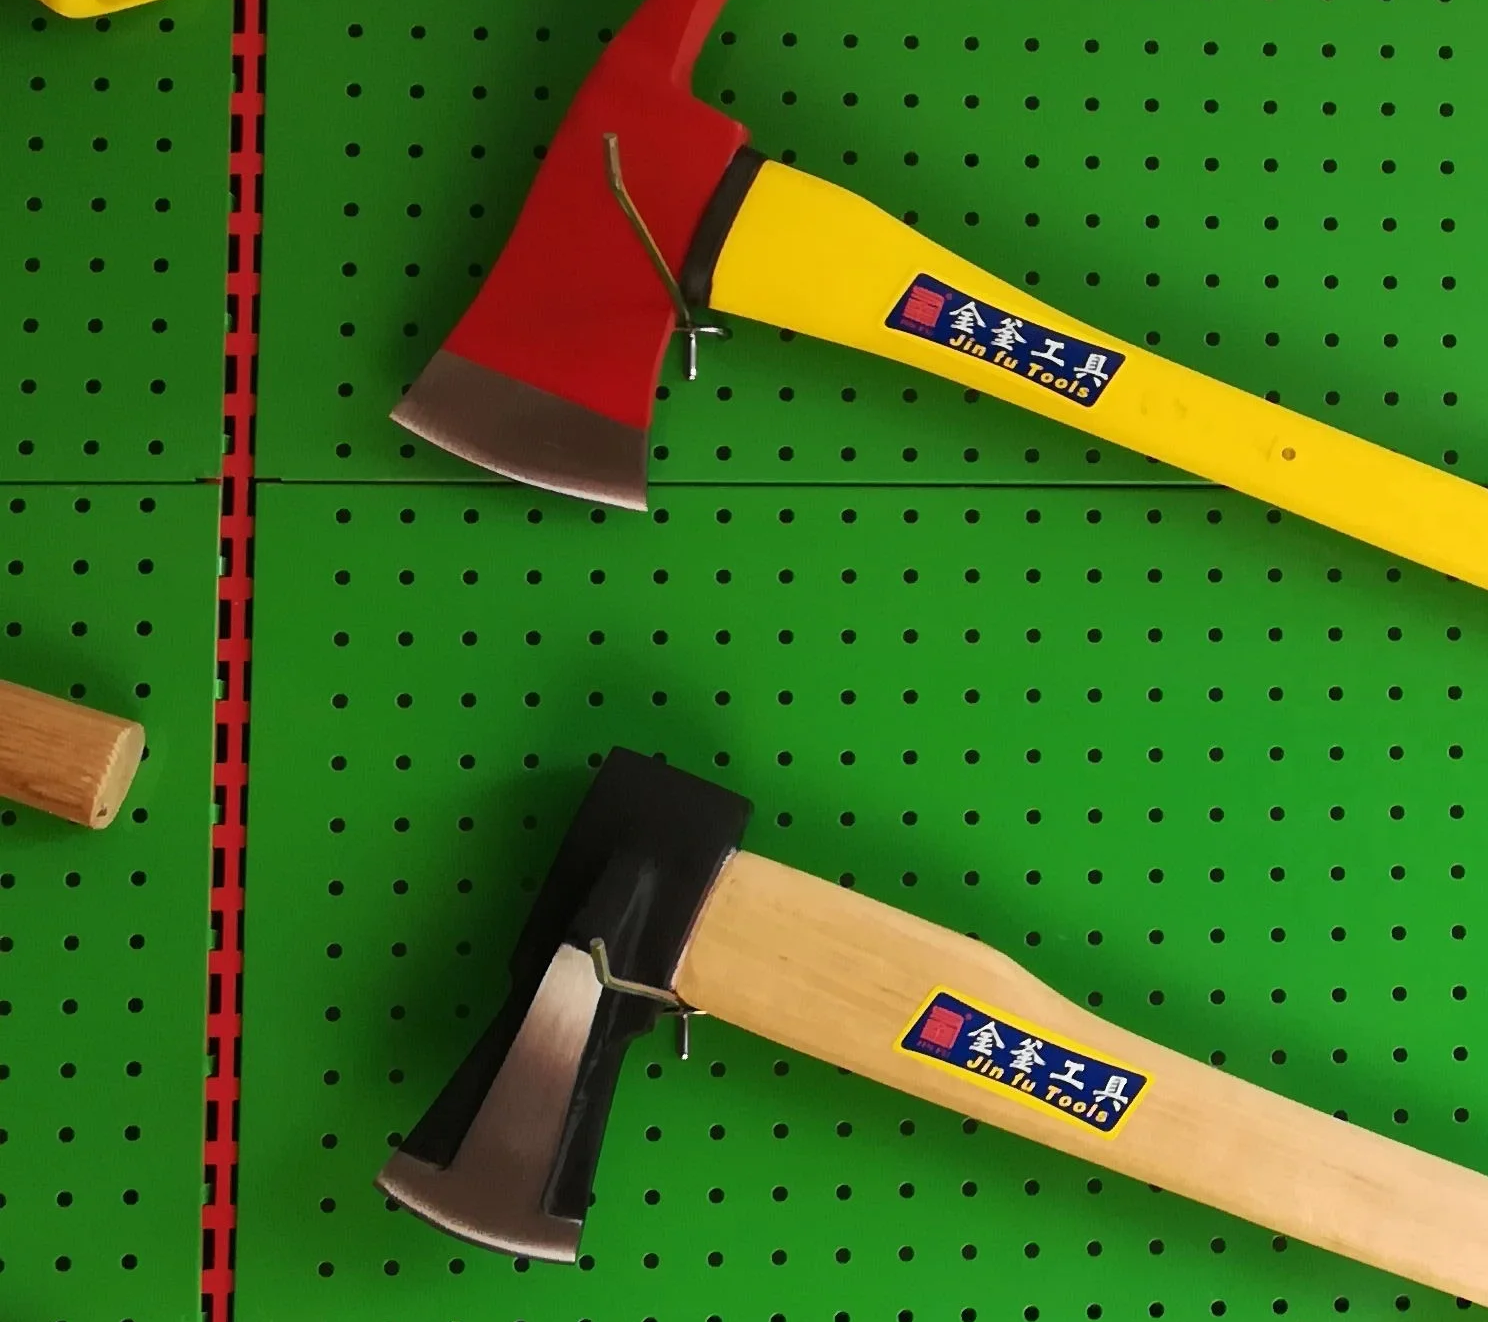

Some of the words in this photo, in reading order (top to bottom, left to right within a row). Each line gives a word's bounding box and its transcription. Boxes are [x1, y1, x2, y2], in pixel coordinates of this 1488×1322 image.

[949, 301, 1109, 388] 金釜工具
[949, 334, 987, 356] Jin
[1027, 362, 1090, 398] Tools
[967, 1021, 1128, 1112] 金釜工具
[967, 1055, 1004, 1079] Jin
[1046, 1085, 1109, 1123] Tools
